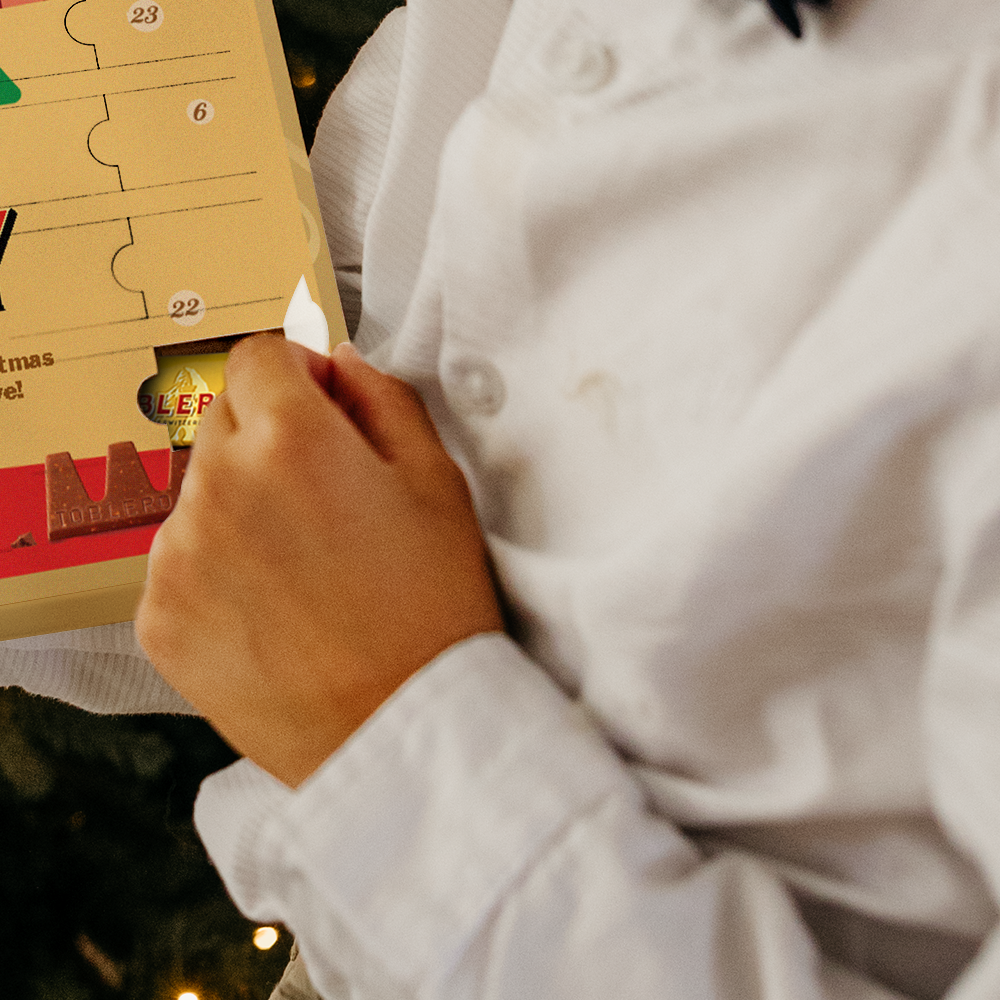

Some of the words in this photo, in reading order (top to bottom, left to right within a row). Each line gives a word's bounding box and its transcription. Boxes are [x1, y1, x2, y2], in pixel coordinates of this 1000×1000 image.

[130, 5, 161, 25] 23
[193, 103, 208, 122] 6
[170, 298, 201, 319] 22
